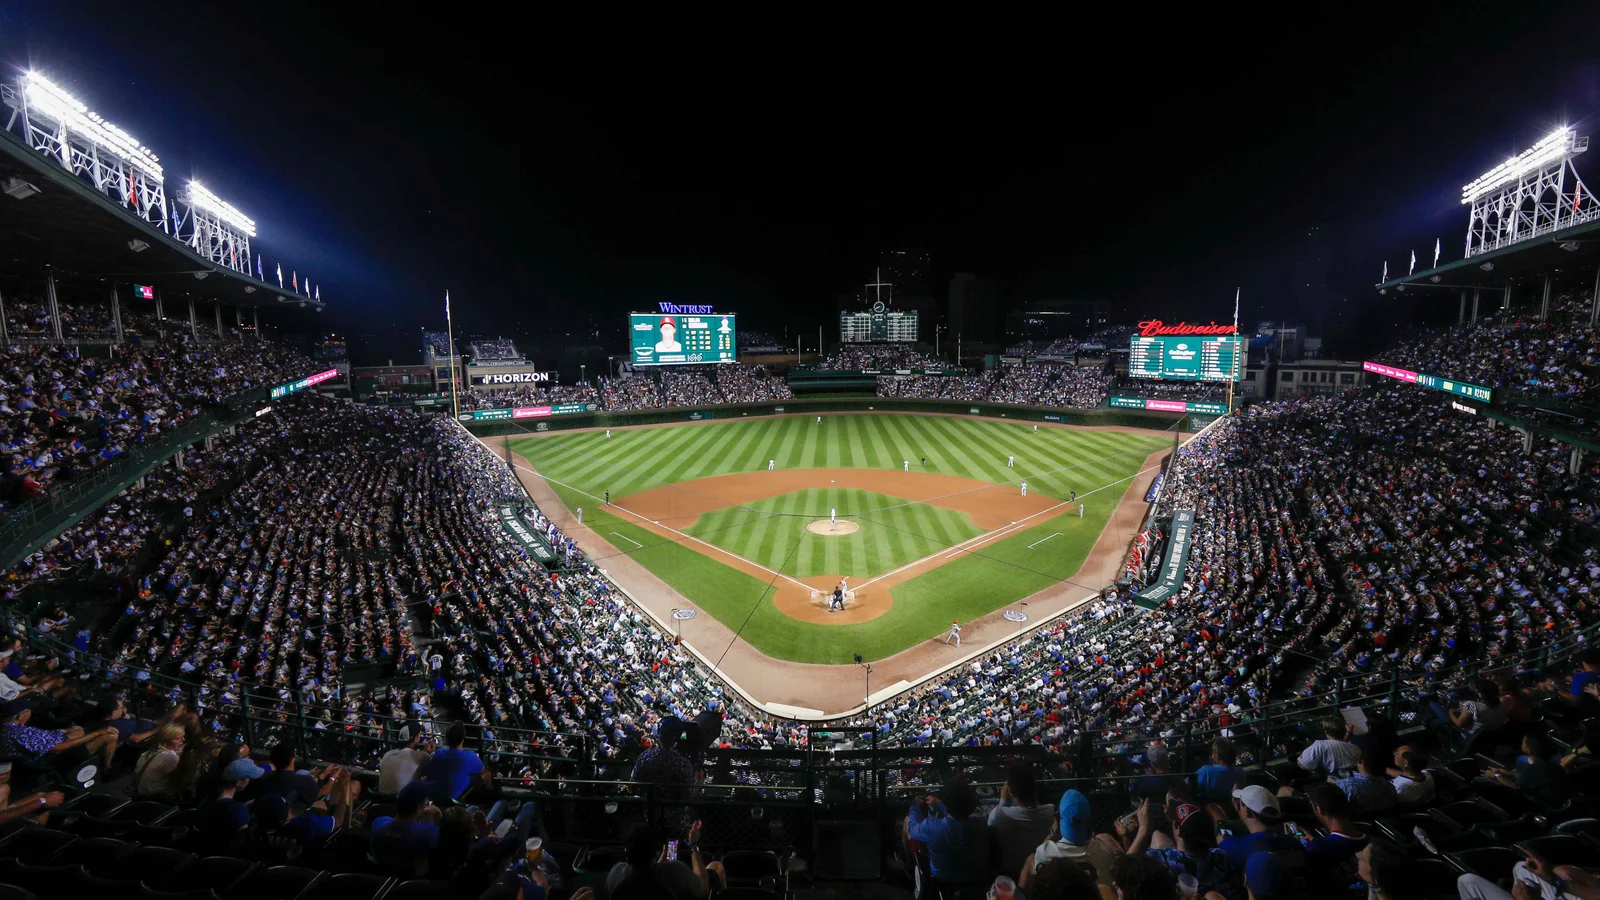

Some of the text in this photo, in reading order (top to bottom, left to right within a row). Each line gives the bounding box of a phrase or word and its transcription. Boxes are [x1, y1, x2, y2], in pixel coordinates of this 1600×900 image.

[659, 302, 713, 314] WINTRUST
[1138, 319, 1238, 336] Budweiser
[494, 372, 549, 384] HORIZON
